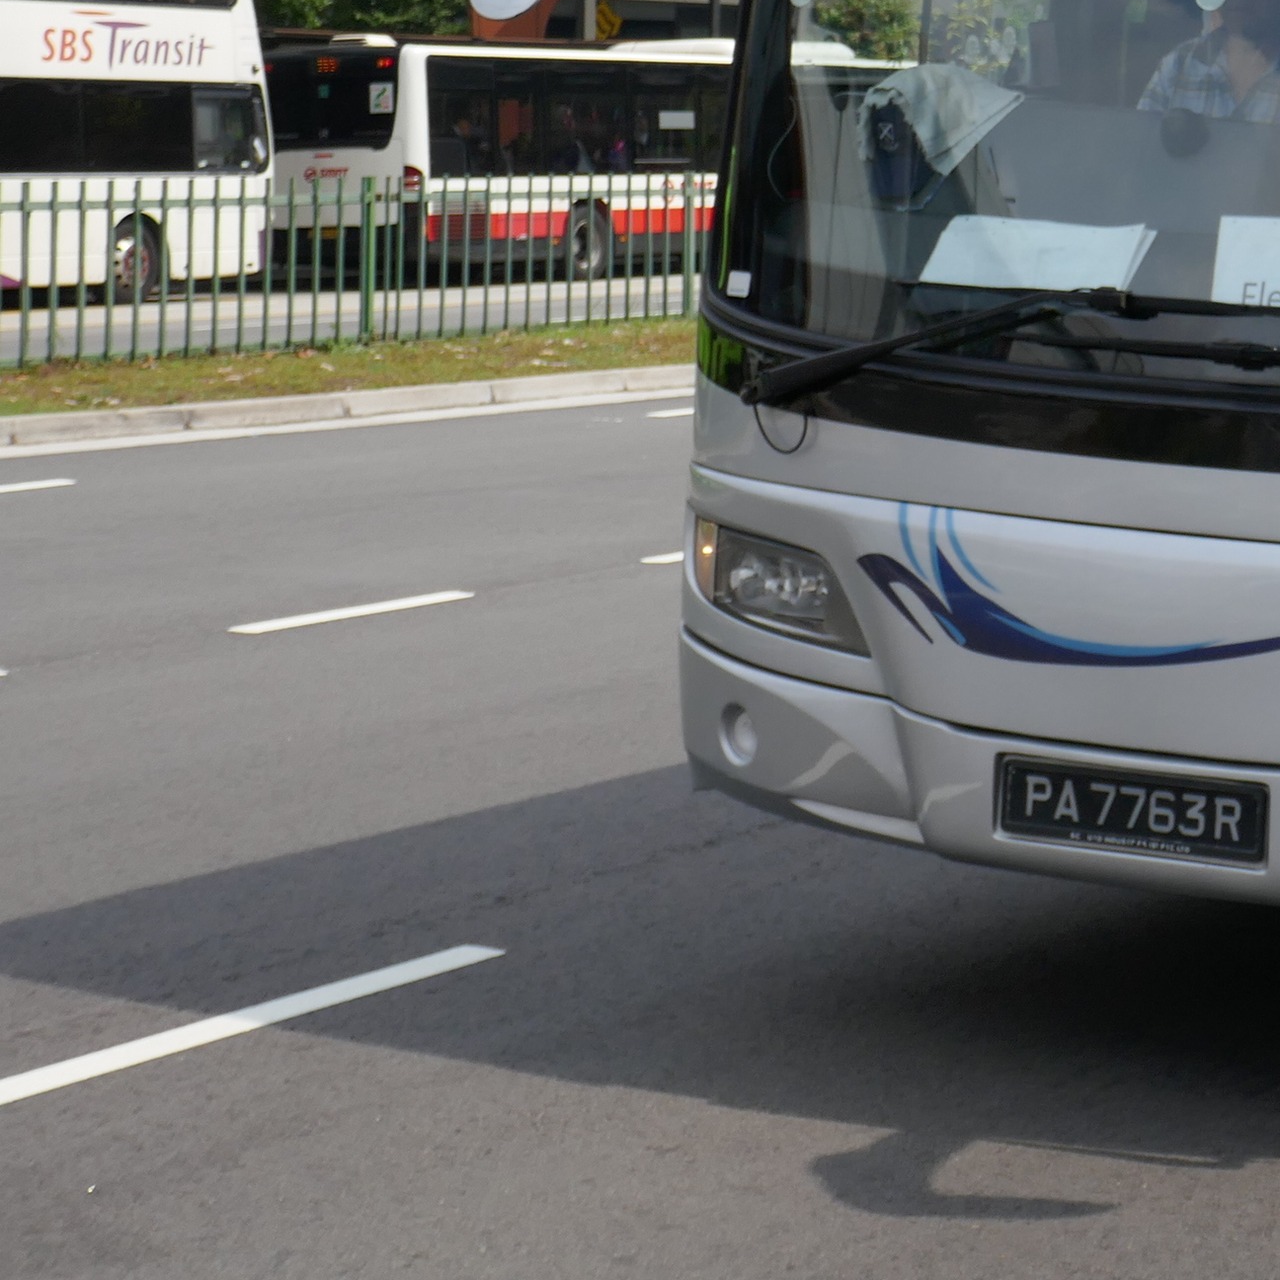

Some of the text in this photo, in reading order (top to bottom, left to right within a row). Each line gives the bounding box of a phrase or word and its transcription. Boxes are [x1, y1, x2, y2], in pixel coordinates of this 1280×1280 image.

[41, 21, 216, 71] SBS Transit
[1025, 775, 1240, 843] PA7763R
